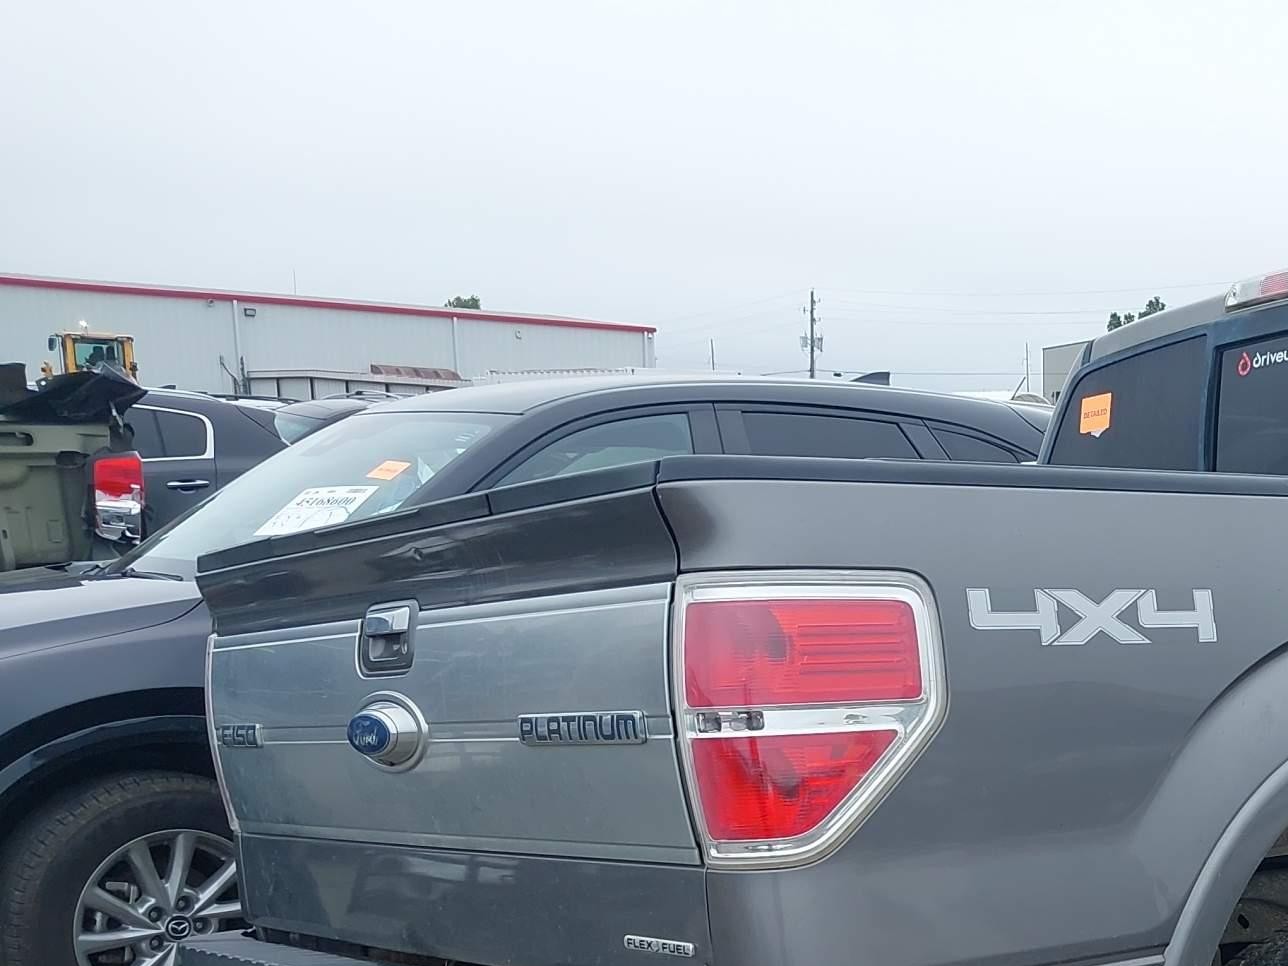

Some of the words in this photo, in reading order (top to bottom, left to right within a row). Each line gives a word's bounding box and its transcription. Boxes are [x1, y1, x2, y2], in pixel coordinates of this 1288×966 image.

[966, 587, 1218, 646] 4X4
[352, 719, 379, 747] Ford
[519, 714, 639, 742] PLATINUM
[626, 937, 653, 951] FLEX
[661, 942, 691, 956] FUEL
